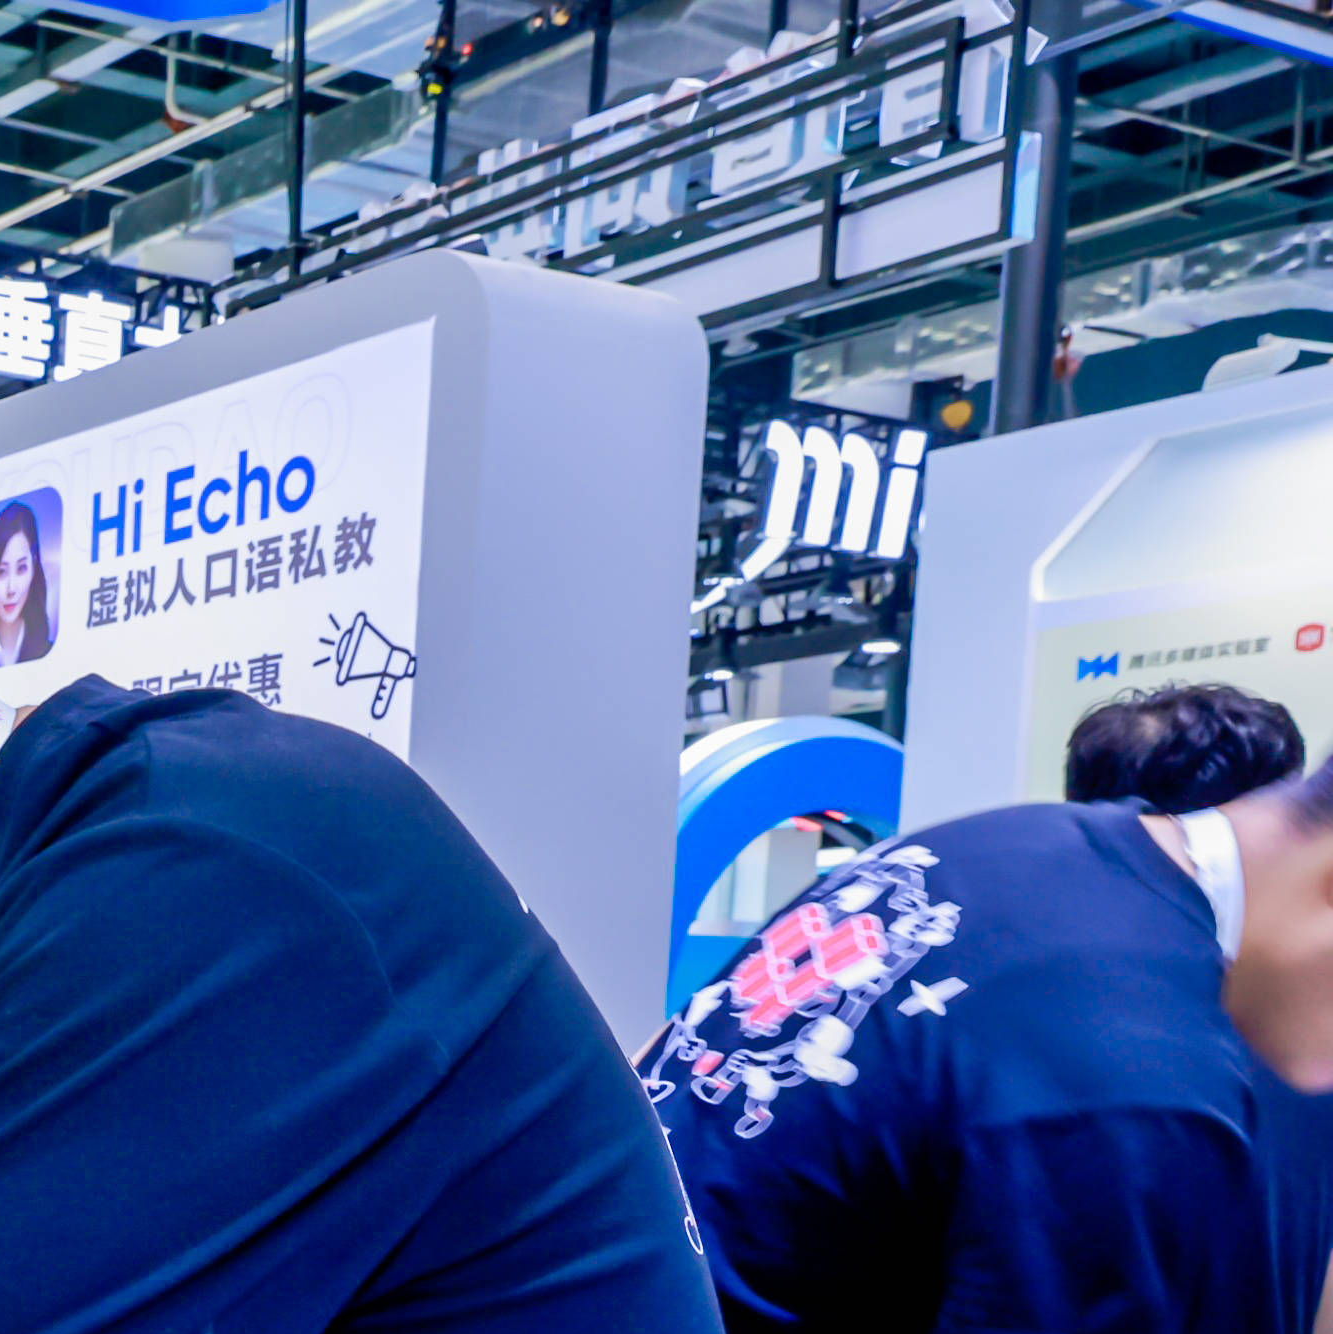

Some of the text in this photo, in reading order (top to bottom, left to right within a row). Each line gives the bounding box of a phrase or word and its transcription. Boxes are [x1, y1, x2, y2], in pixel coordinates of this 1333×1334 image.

[90, 448, 316, 564] Hi Echo
[766, 418, 926, 559] mi
[86, 511, 377, 630] 虚拟人口语私教
